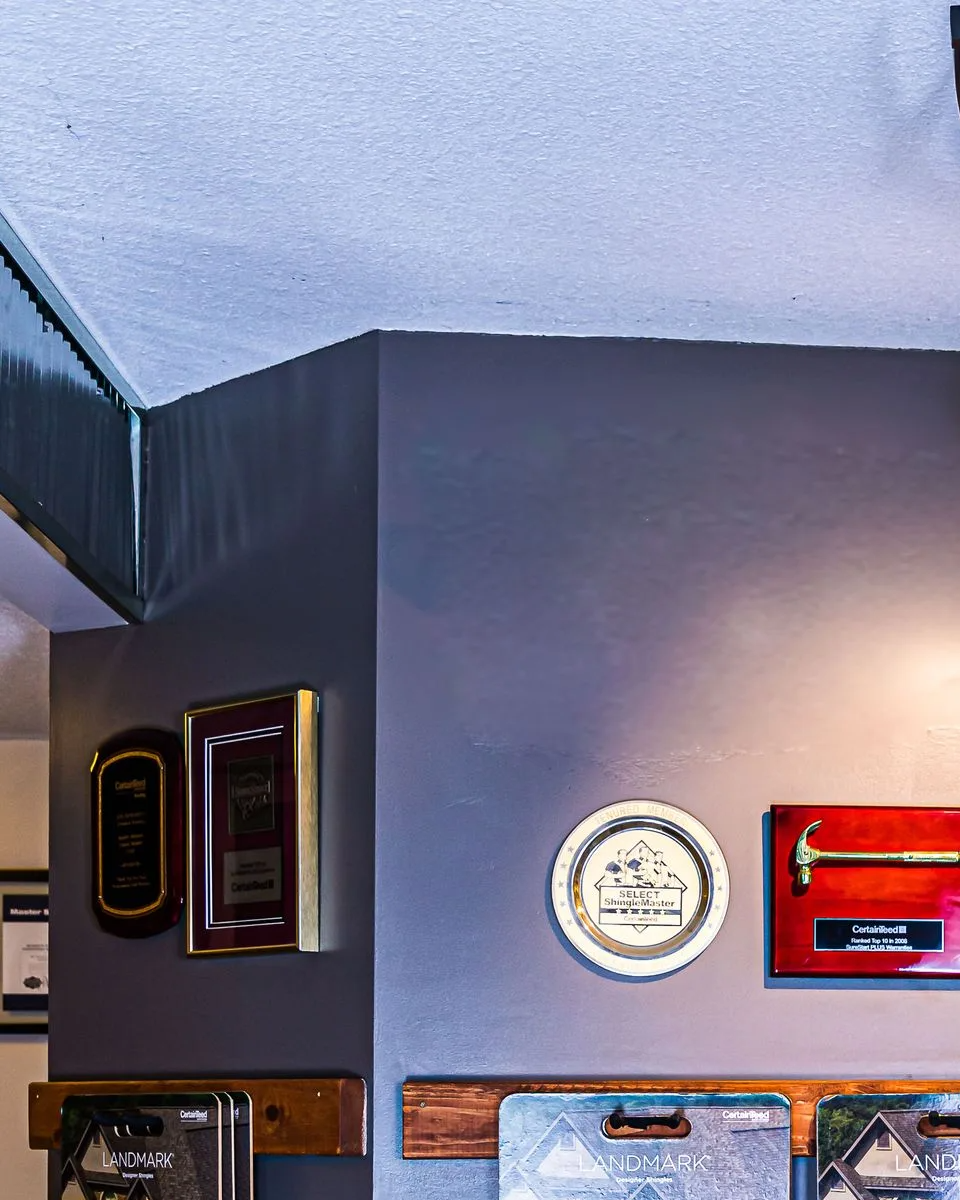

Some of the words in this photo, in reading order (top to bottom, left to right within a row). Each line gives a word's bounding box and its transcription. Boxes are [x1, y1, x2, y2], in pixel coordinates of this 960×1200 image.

[620, 890, 660, 898] SELECT
[604, 898, 675, 908] ShingleMaster
[10, 908, 42, 916] Master
[852, 925, 898, 933] CertainTeed
[180, 1110, 208, 1119] CertainTeed
[722, 1110, 769, 1120] CertainTeed
[102, 1152, 173, 1168] LANDMARK
[580, 1155, 708, 1172] LANDMARK
[616, 1176, 645, 1184] Designer
